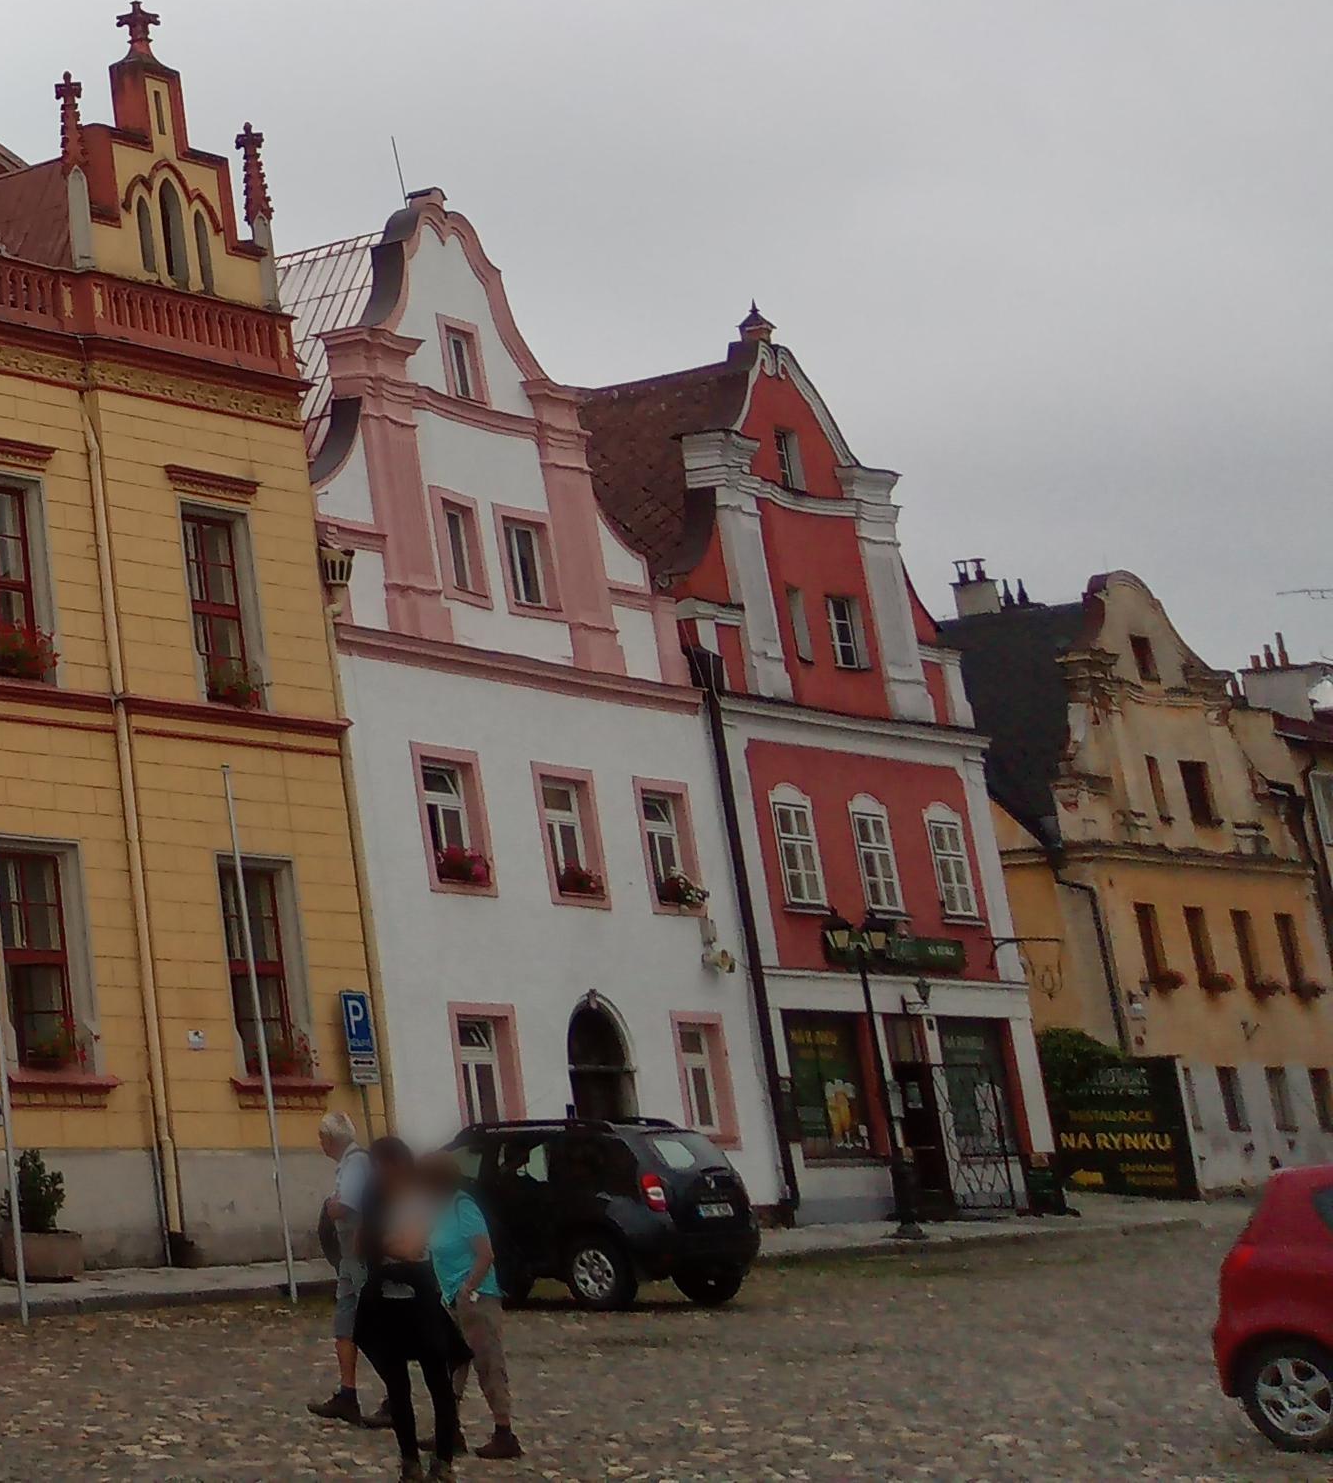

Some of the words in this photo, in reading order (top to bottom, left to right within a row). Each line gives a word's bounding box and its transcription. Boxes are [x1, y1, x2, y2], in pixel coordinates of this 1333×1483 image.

[348, 1000, 364, 1036] P
[1060, 1132, 1092, 1150] NA
[1095, 1132, 1173, 1151] RYNKU
